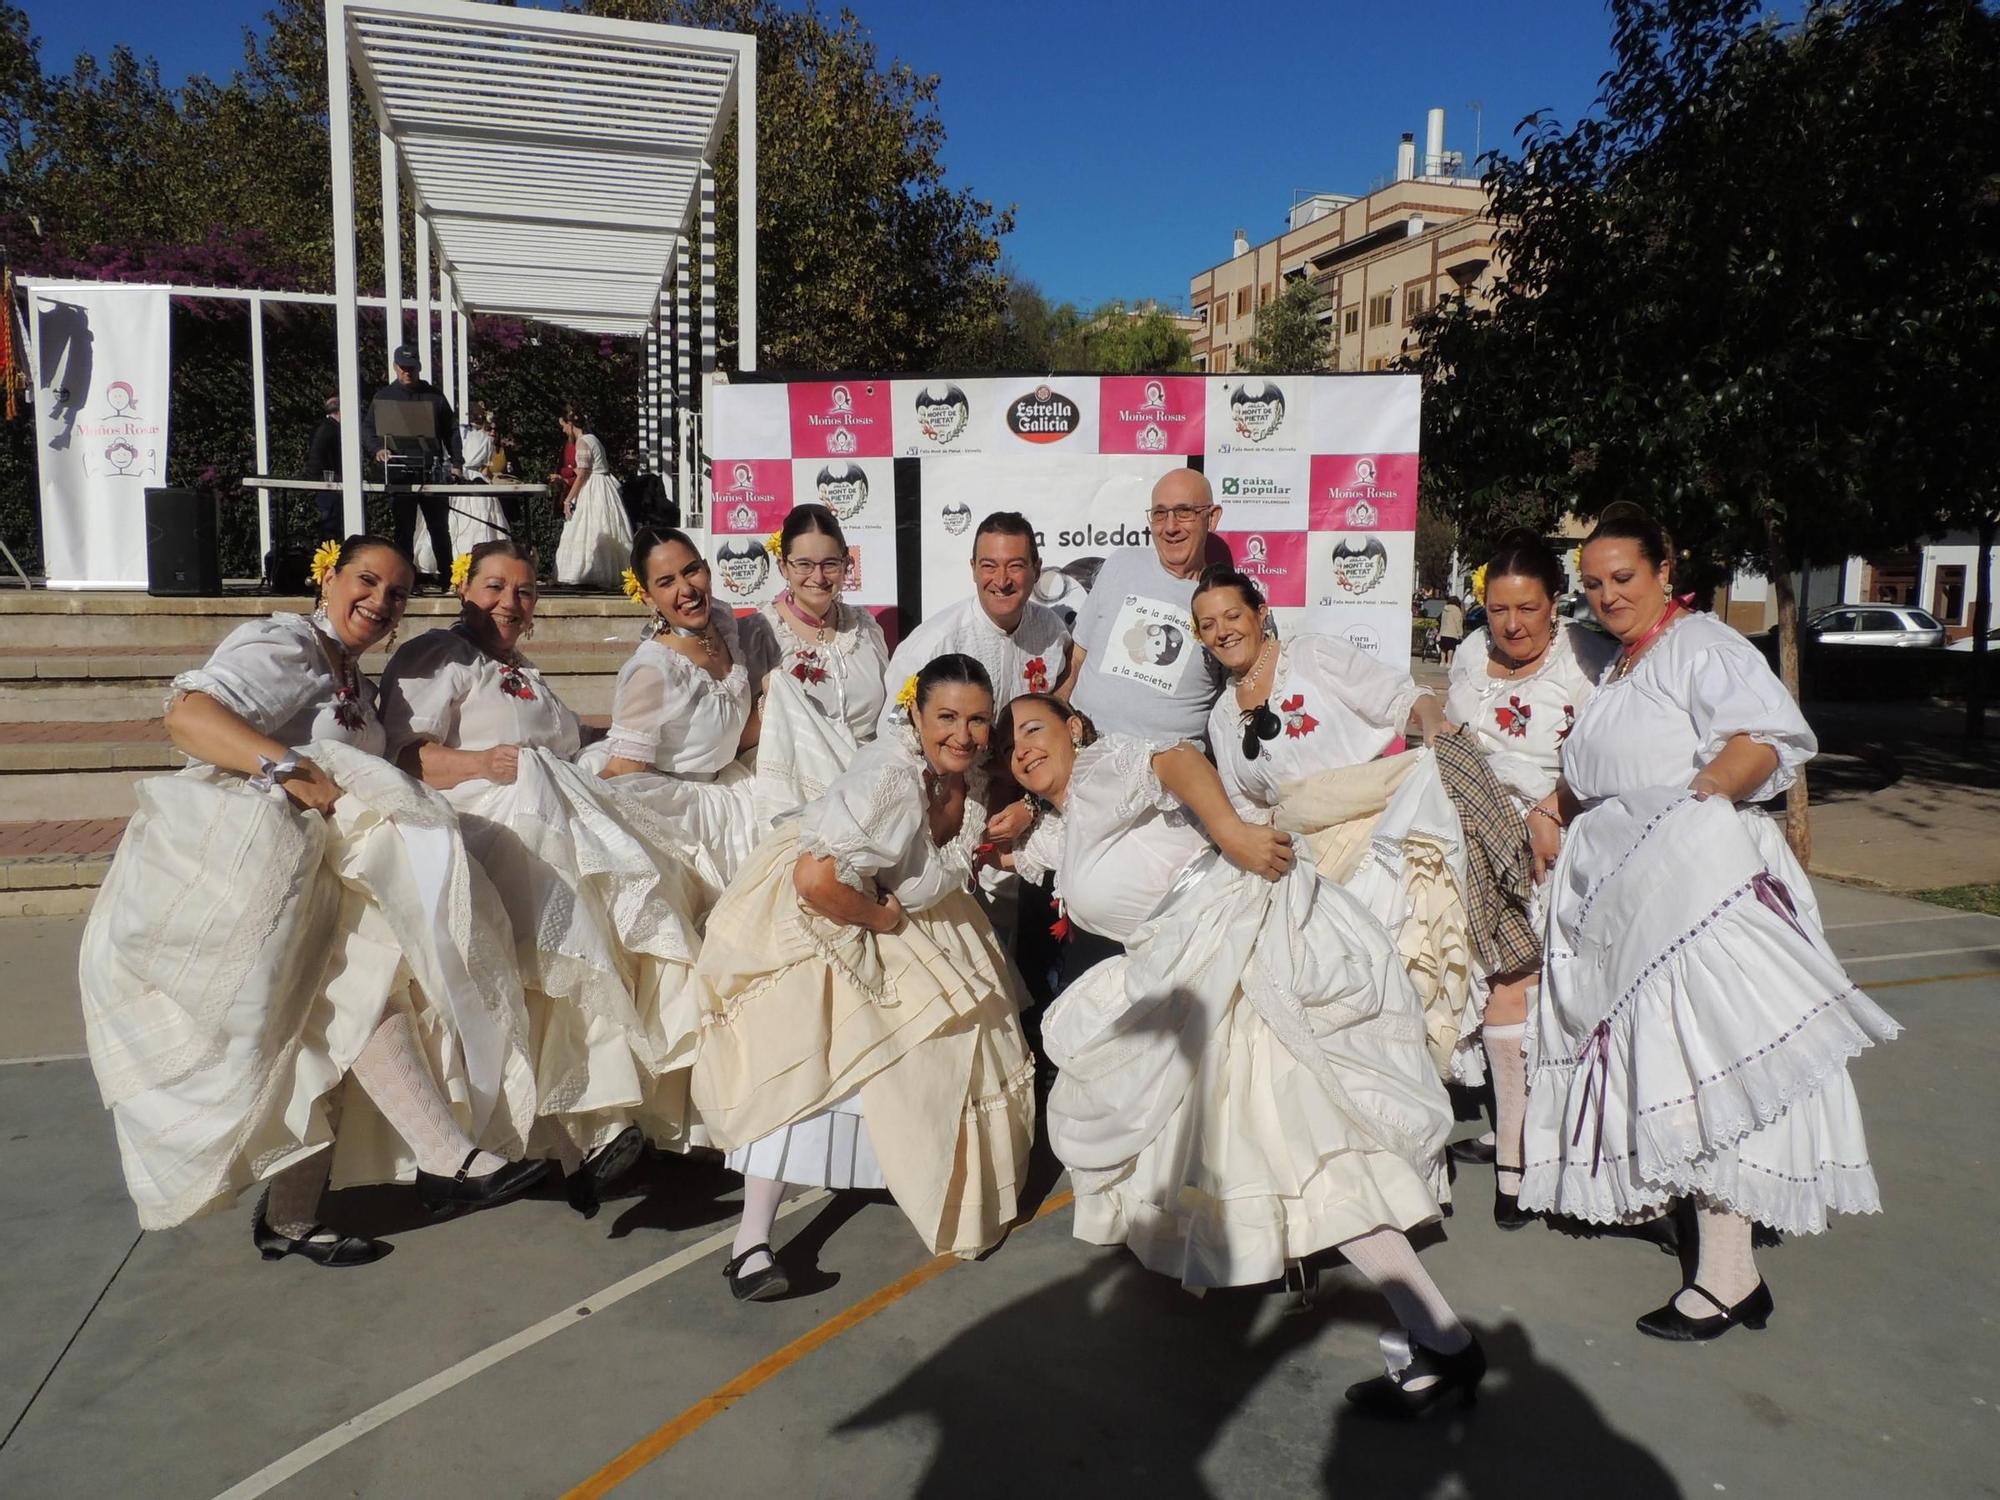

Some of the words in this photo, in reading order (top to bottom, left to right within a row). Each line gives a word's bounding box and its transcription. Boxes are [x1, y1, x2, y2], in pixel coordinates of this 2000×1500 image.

[1016, 402, 1072, 417] Estrella
[1119, 410, 1153, 421] Moños
[1156, 410, 1187, 421] Rosas
[808, 414, 842, 426] Moños
[844, 414, 874, 425] Rosas
[1018, 416, 1068, 432] Galicia
[1243, 477, 1274, 486] caixa
[1242, 485, 1291, 495] popular
[1328, 488, 1364, 499] Moños
[1367, 487, 1398, 498] Rosas
[745, 491, 775, 502] Rosas
[1034, 531, 1046, 547] a
[1058, 523, 1151, 547] soledat
[1257, 563, 1288, 575] Rosas
[1136, 606, 1147, 614] de
[1151, 609, 1160, 618] la
[1163, 613, 1194, 632] soleda
[1121, 665, 1130, 675] la
[1133, 671, 1173, 691] societat
